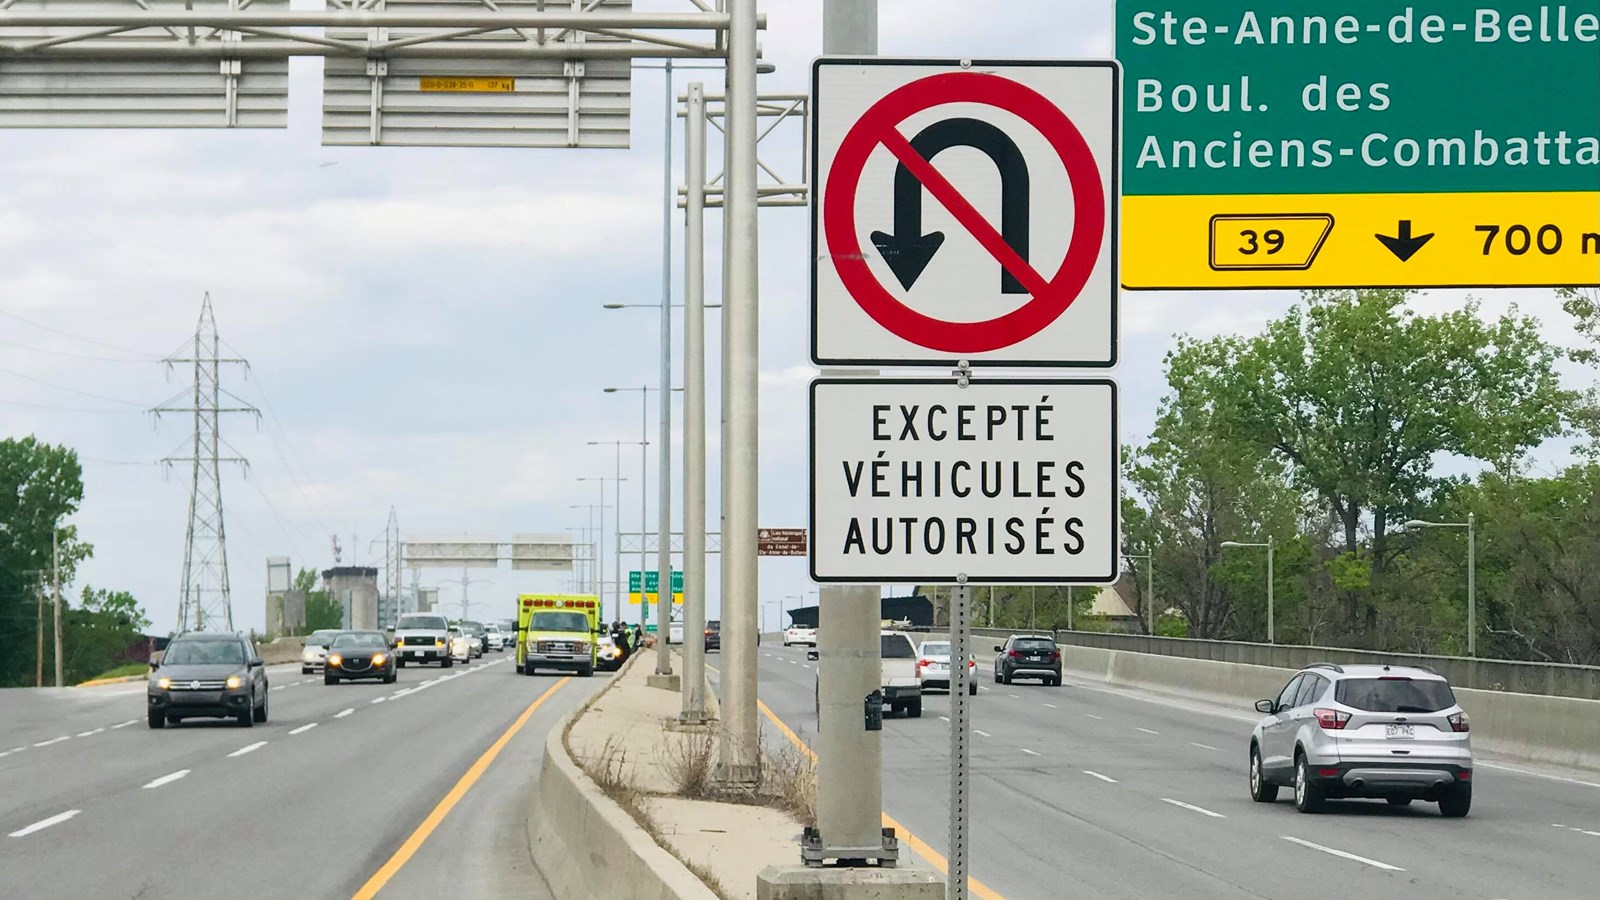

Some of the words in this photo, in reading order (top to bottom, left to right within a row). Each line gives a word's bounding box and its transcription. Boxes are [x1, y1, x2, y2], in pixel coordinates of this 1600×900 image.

[1136, 76, 1268, 113] Boul.
[1301, 75, 1391, 112] des
[1135, 129, 1600, 169] Anciens-Combatta
[1238, 229, 1285, 255] 39
[1474, 223, 1563, 256] 700
[872, 395, 1055, 441] EXCEPTÉ
[842, 450, 1086, 498] VÉHICULES
[842, 506, 1086, 556] AUTORISÉS
